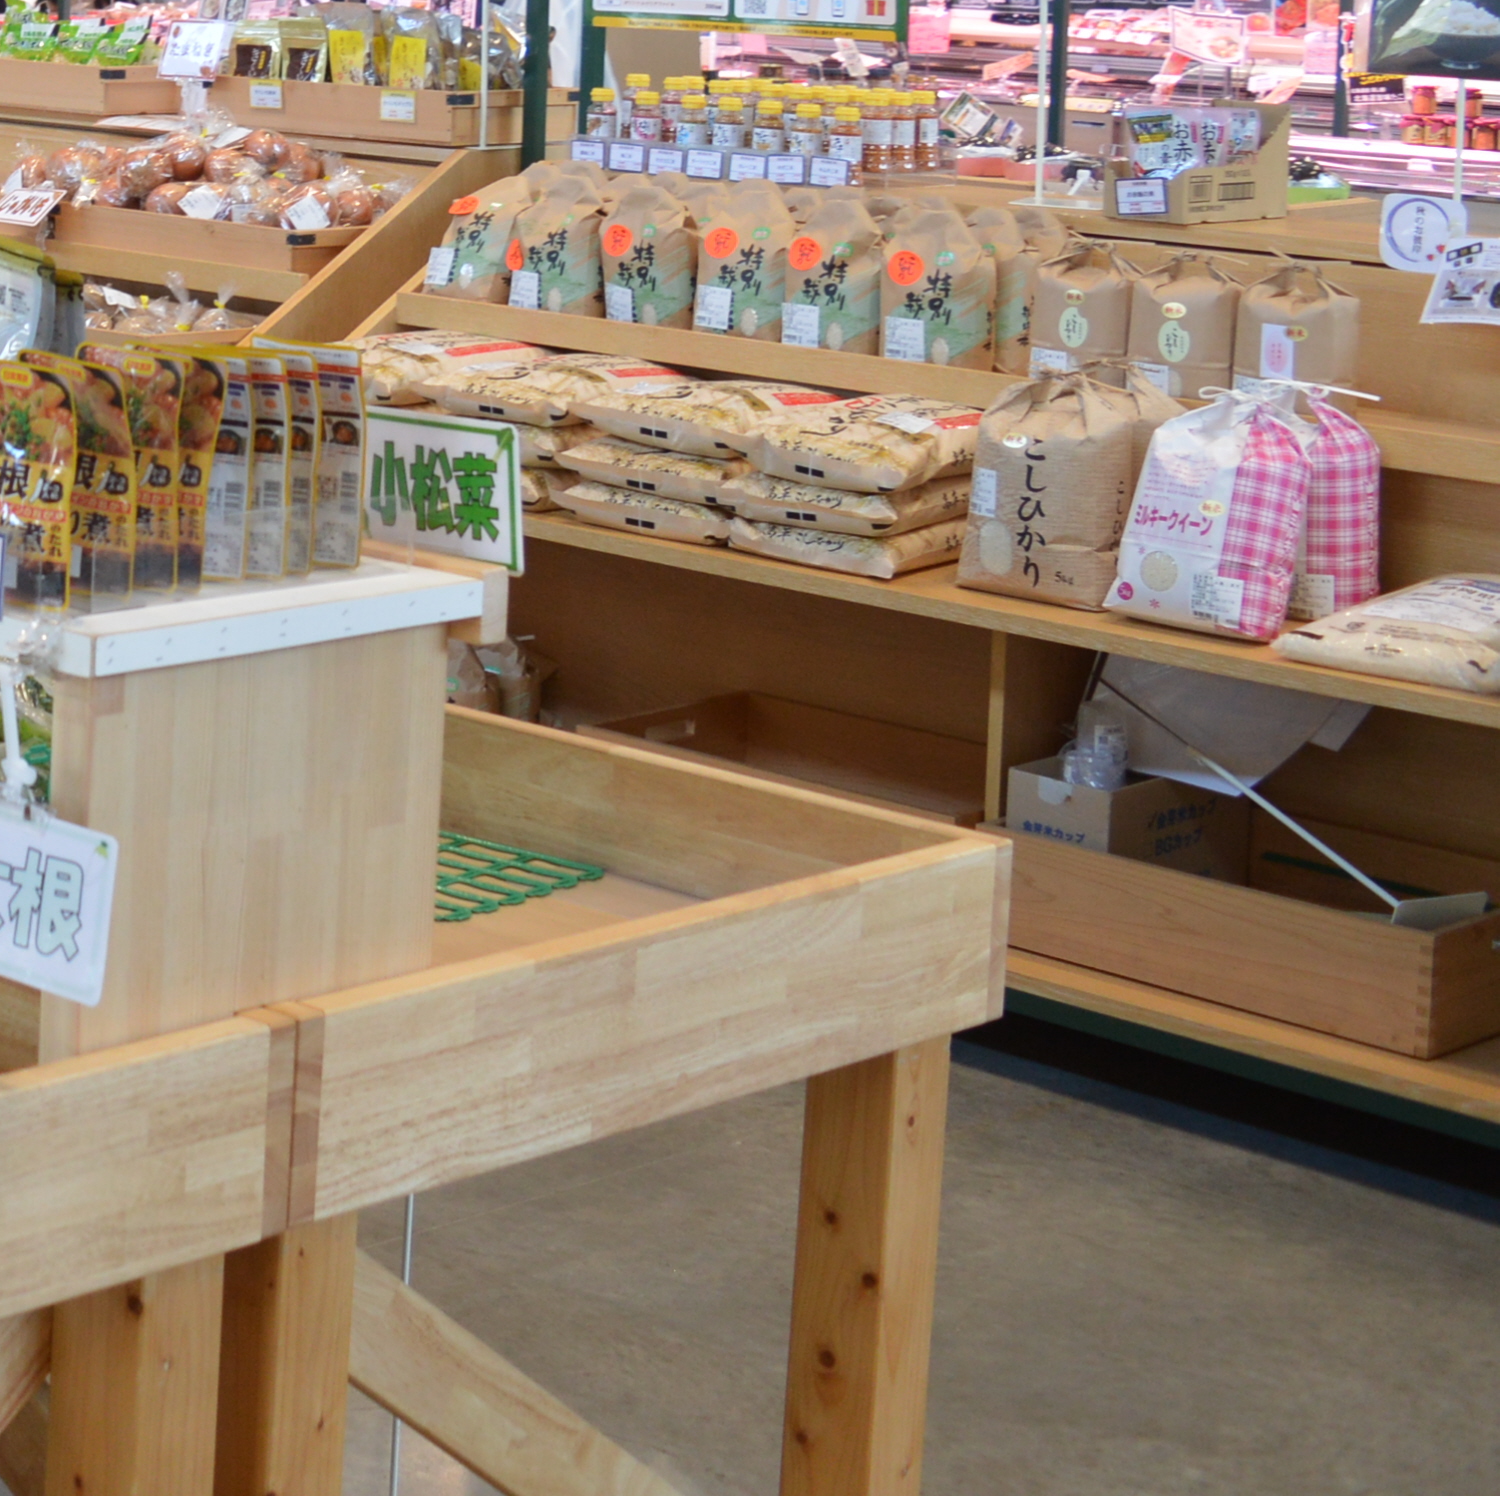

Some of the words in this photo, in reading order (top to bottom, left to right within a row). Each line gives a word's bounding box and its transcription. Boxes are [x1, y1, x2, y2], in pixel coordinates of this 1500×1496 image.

[468, 211, 495, 253] 特別
[546, 229, 569, 276] 特別
[631, 239, 658, 292] 特別
[739, 243, 765, 297] 特別
[819, 256, 849, 312] 特別
[926, 267, 954, 326] 特別
[372, 438, 499, 543] 小松菜
[1015, 436, 1048, 588] こしひかり
[1134, 504, 1214, 537] ミルキークイーン
